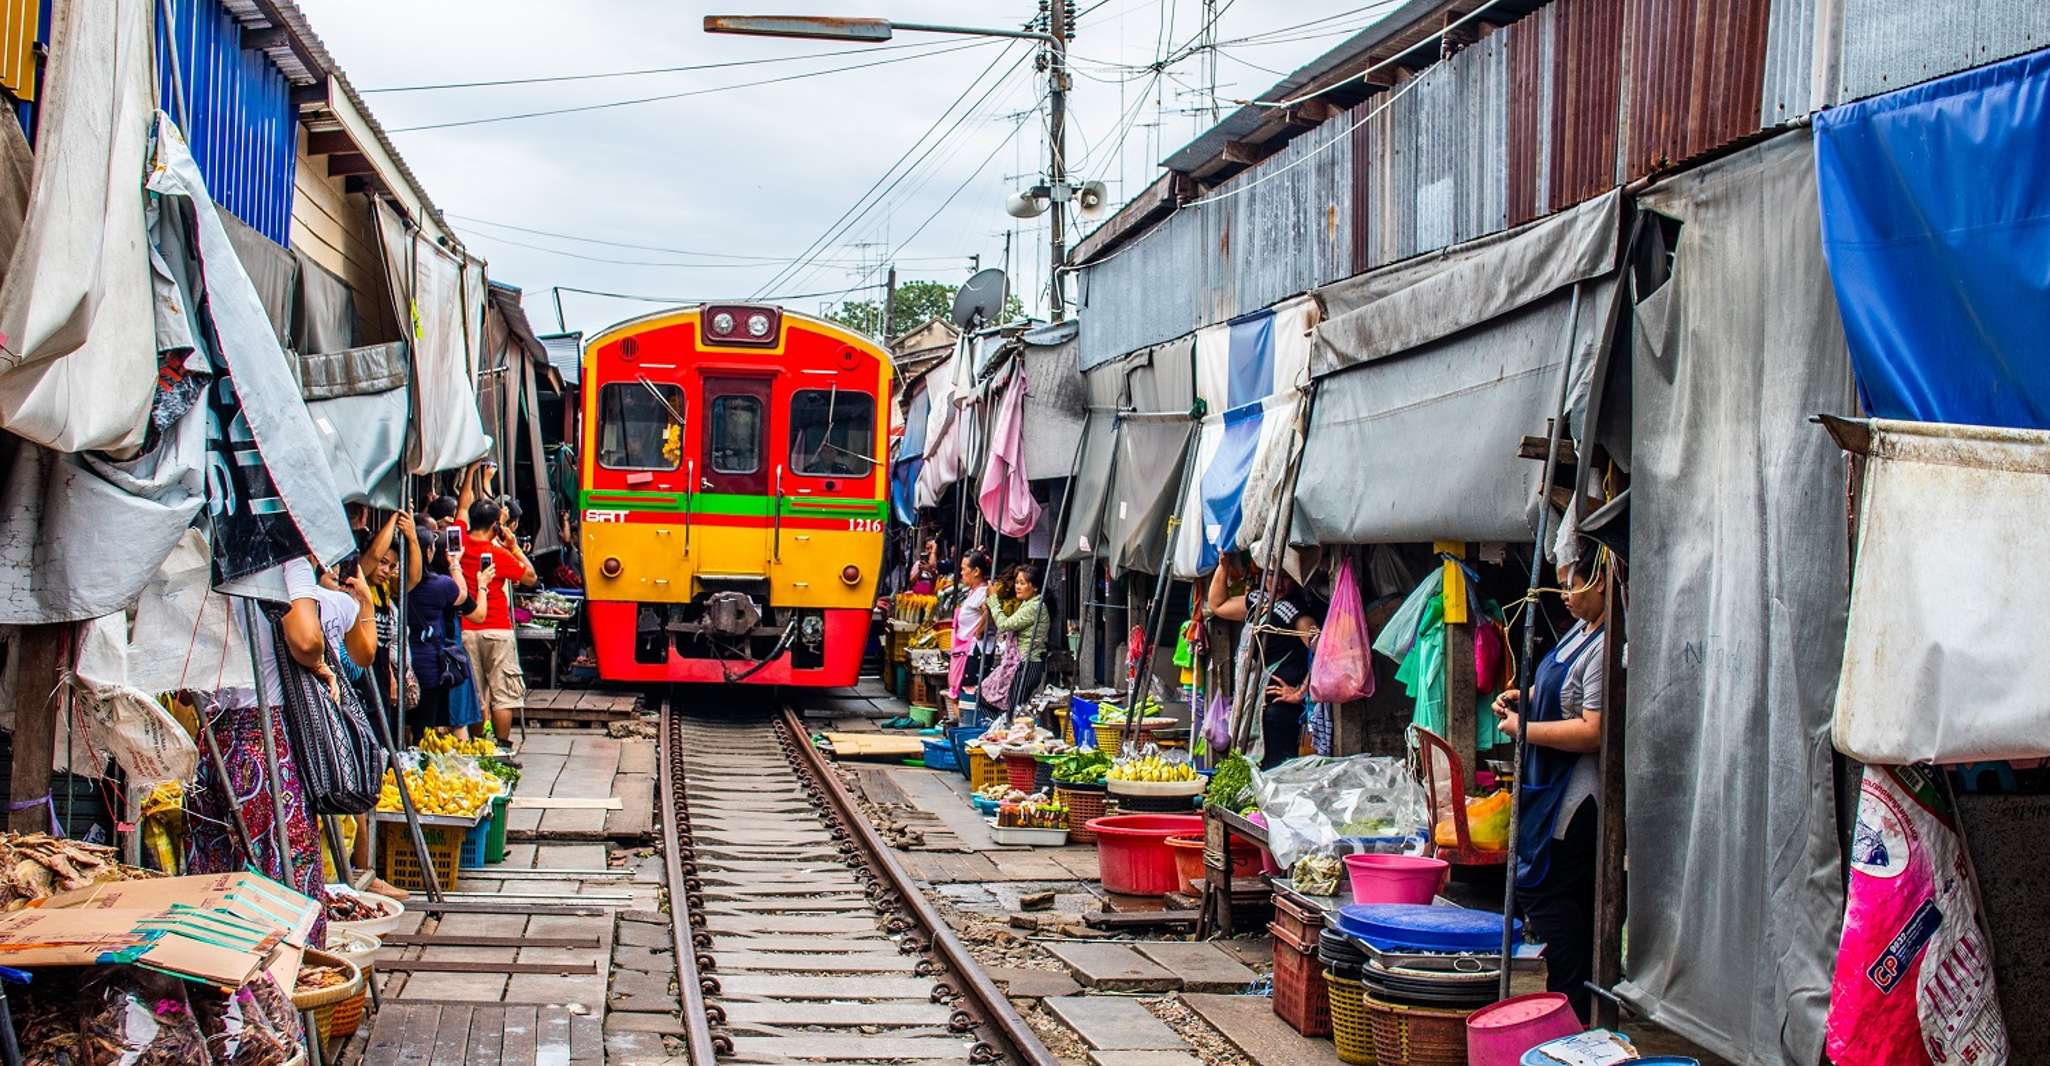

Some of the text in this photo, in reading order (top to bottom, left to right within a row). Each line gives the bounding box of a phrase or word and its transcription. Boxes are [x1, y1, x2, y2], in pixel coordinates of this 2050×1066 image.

[586, 509, 629, 523] SRT
[849, 518, 881, 532] 1216
[1874, 955, 1898, 986] CP
